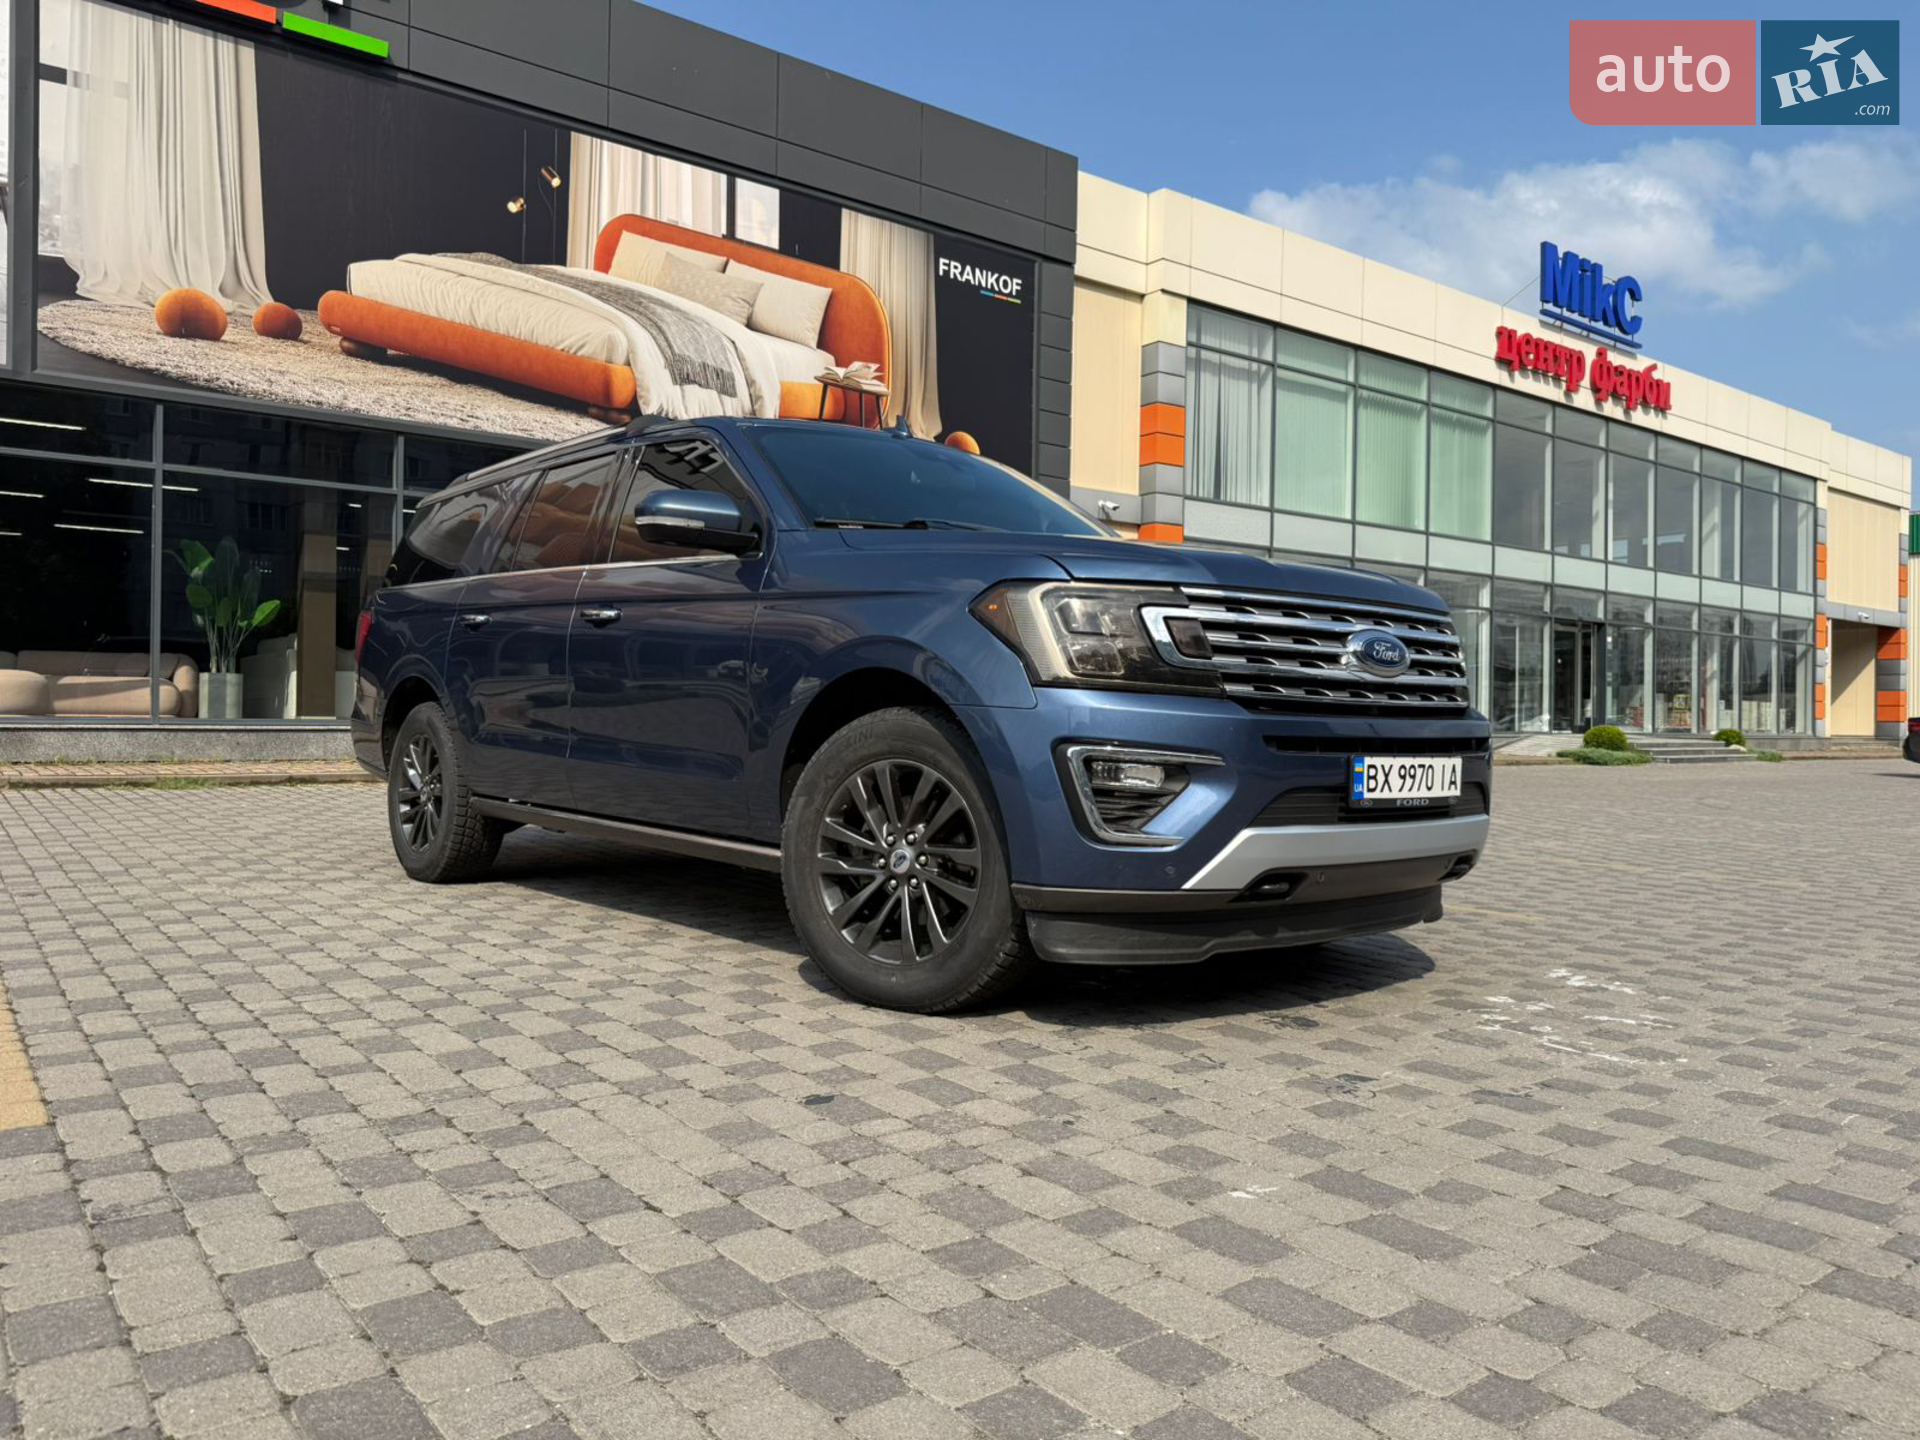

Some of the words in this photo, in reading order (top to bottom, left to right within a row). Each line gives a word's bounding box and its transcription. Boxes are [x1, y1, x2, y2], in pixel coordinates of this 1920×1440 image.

[939, 257, 1022, 296] FRANKOF
[1495, 325, 1586, 393] центр
[1590, 347, 1672, 411] фарби
[1373, 640, 1400, 662] Ford
[1366, 764, 1394, 793] BX
[1398, 764, 1435, 793] 9970
[1441, 764, 1459, 792] IA
[1396, 798, 1430, 807] FORD
